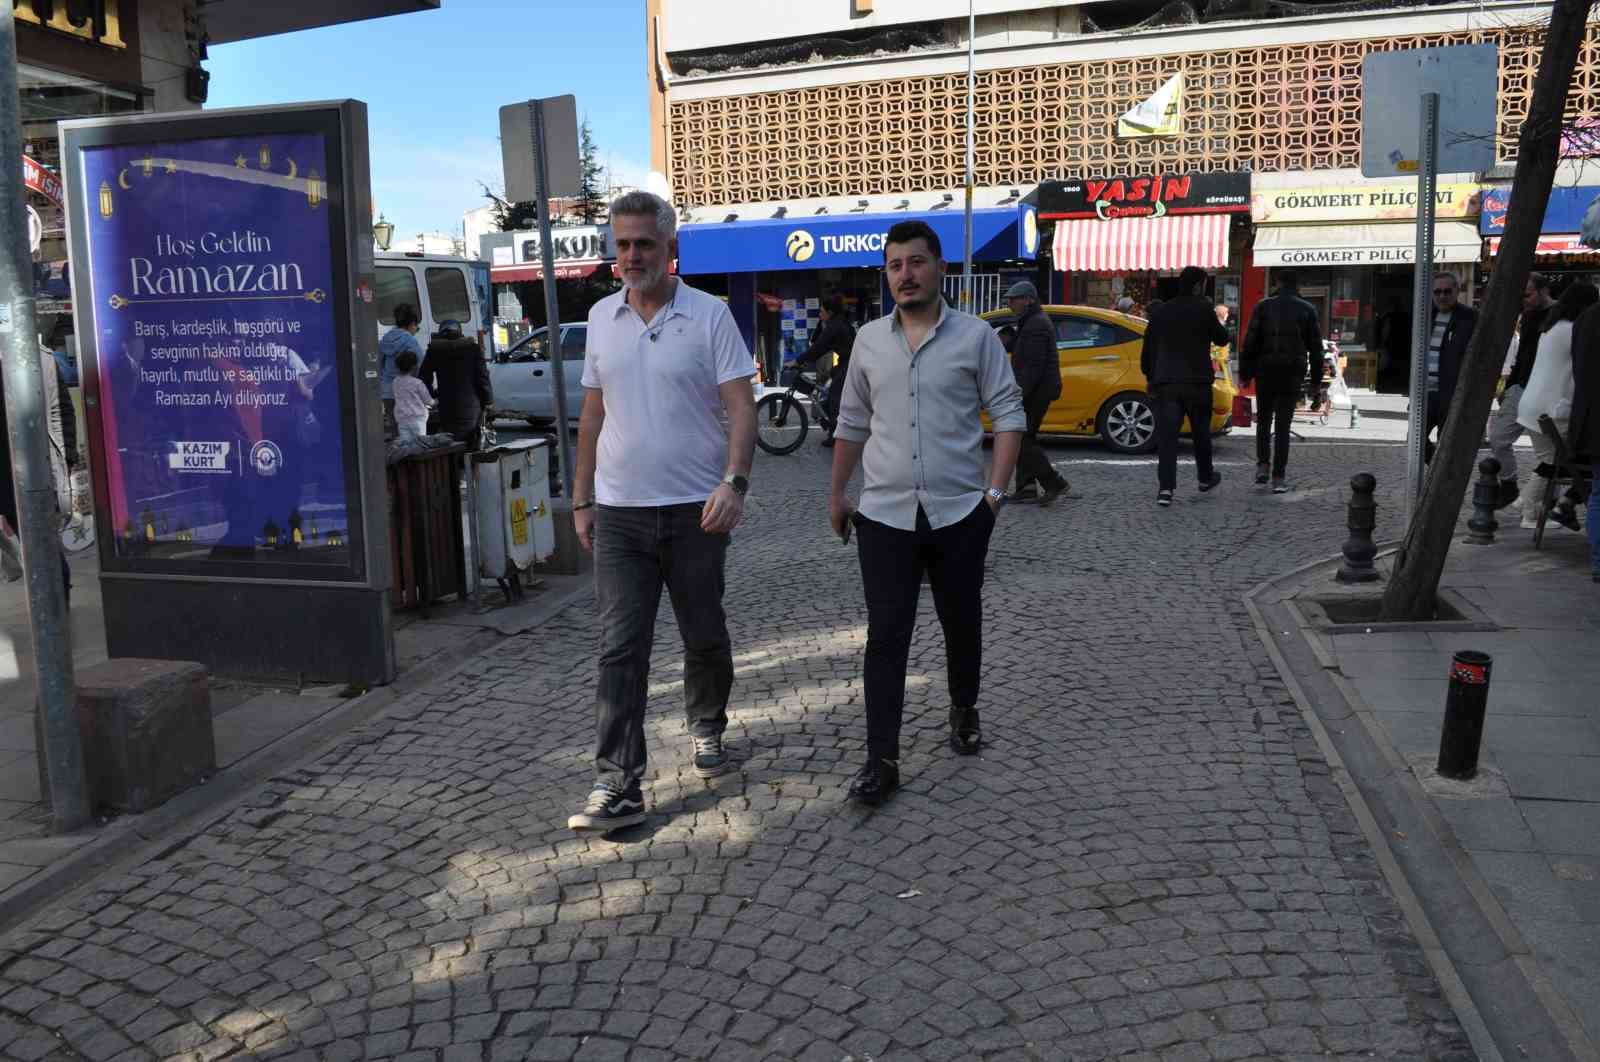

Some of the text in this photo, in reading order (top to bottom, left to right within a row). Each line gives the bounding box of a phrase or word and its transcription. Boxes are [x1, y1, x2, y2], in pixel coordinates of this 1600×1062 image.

[1274, 191, 1364, 209] GÖKMERT
[1369, 187, 1417, 208] PİLİÇ
[156, 230, 272, 259] Hoş Geldin
[1281, 250, 1364, 263] GÖKMERT
[130, 257, 303, 296] Ramazan
[135, 320, 169, 339] Barış,
[287, 320, 301, 333] ve
[151, 344, 200, 362] sevginin
[184, 367, 219, 383] mutlu
[222, 369, 236, 383] ve
[239, 366, 281, 385] sağlıklı
[156, 390, 212, 405] Ramazan
[214, 389, 233, 407] Ayı
[183, 443, 223, 455] KAZIM
[184, 456, 215, 467] KURT
